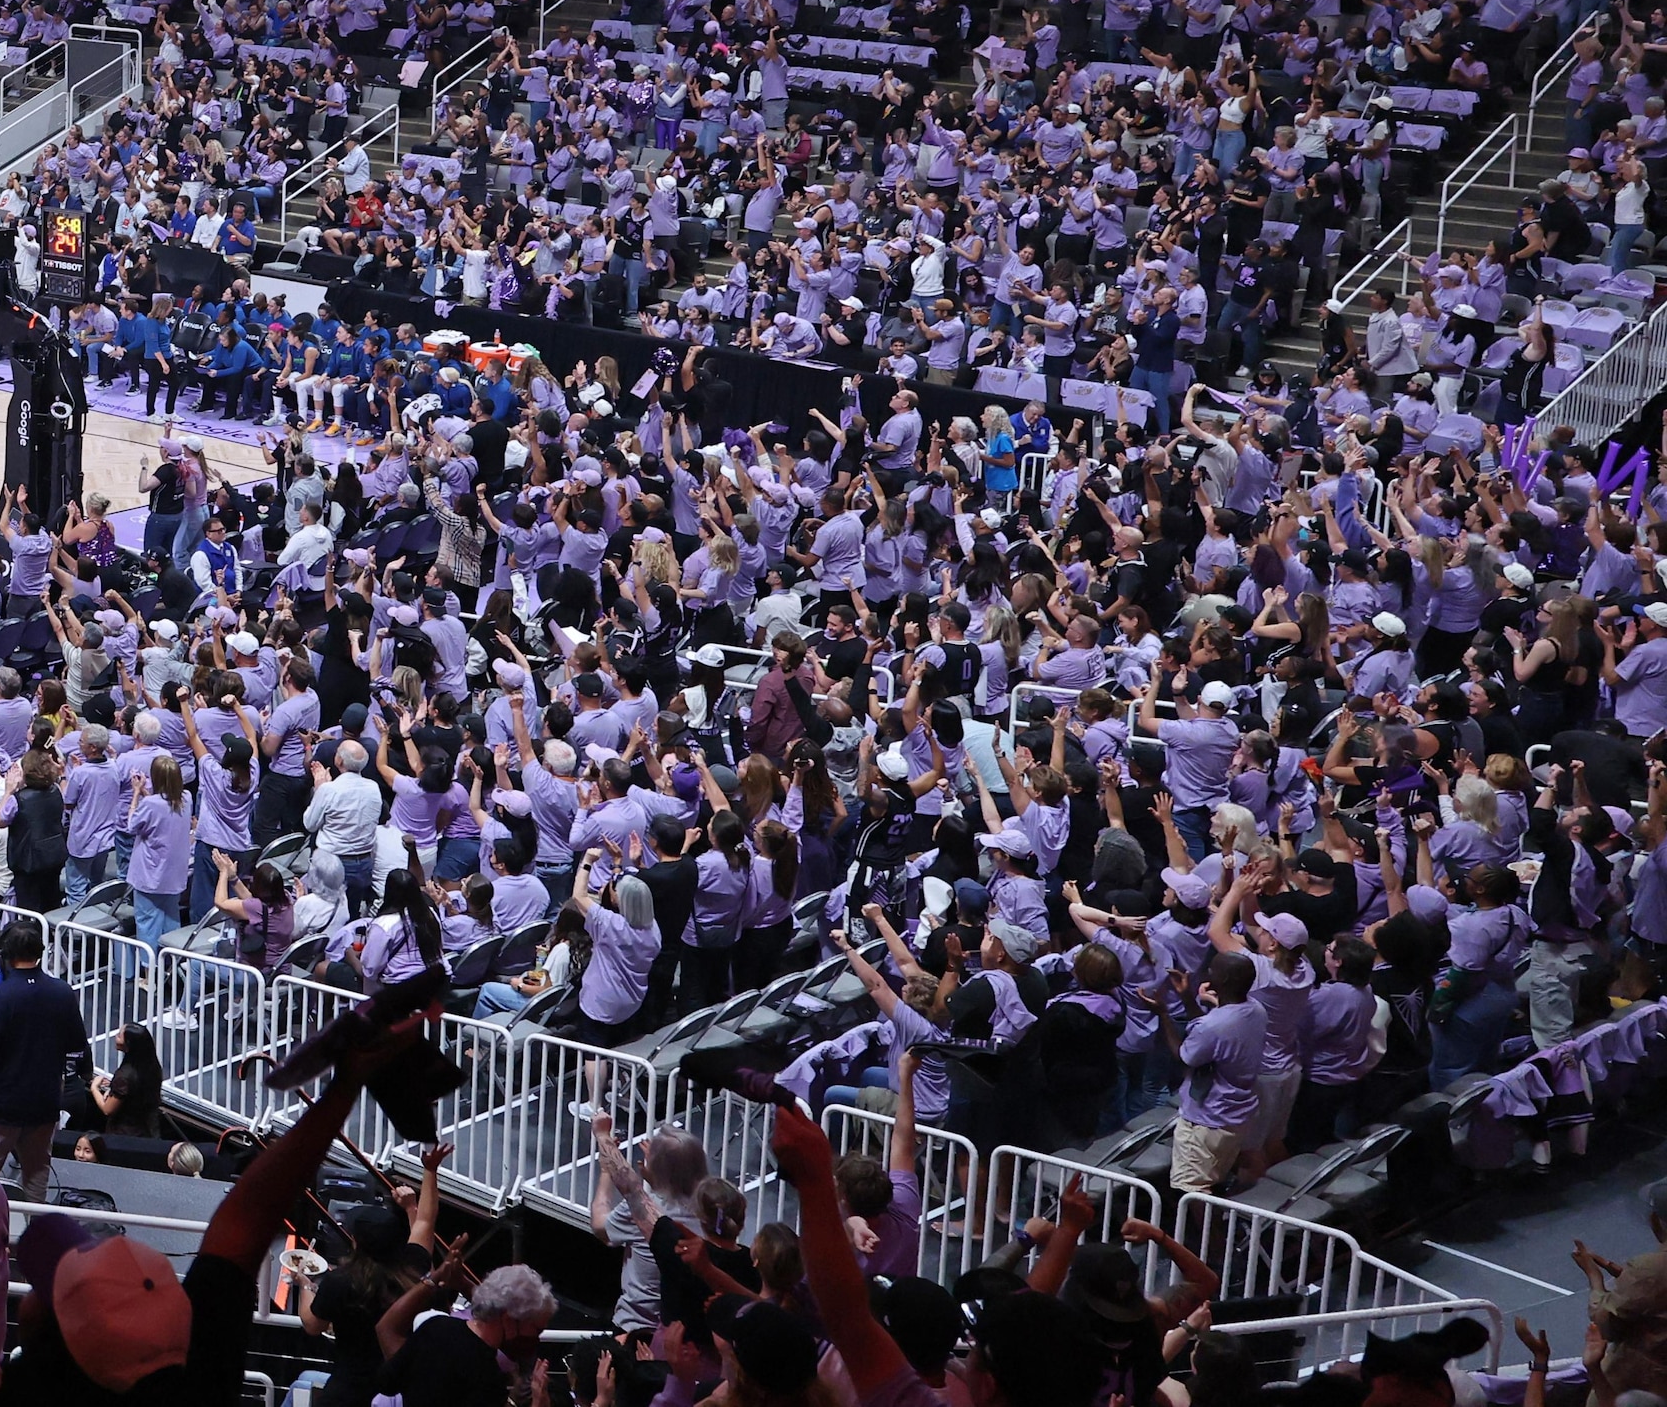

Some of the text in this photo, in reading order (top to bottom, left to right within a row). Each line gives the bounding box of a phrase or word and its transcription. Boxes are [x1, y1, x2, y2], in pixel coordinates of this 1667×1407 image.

[56, 216, 81, 234] 5:48
[55, 234, 76, 253] 24
[55, 263, 83, 272] TISSOT
[182, 321, 204, 331] WNBA
[17, 399, 29, 448] Google
[962, 658, 972, 680] 0
